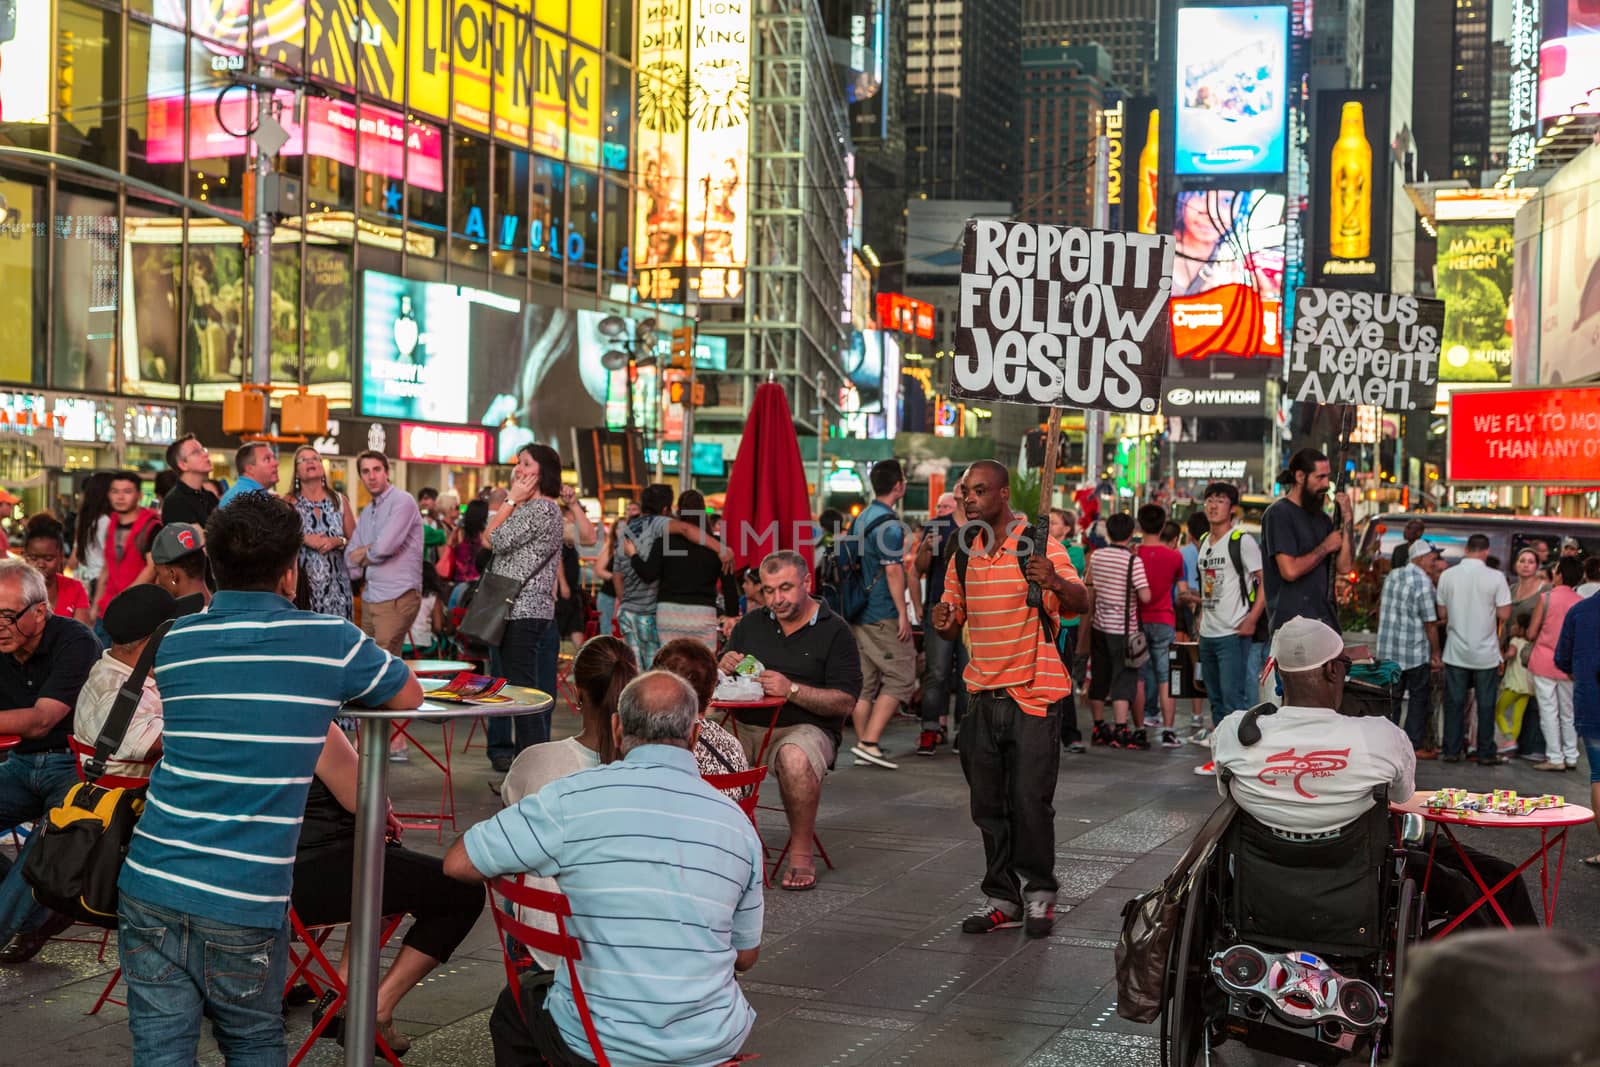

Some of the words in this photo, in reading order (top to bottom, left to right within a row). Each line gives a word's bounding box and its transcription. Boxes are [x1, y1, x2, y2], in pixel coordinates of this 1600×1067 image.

[699, 0, 741, 19] LION
[696, 24, 745, 49] KING
[423, 0, 505, 77] LION
[513, 4, 589, 111] KING
[1103, 99, 1123, 204] NOVOTEL
[975, 219, 1176, 290] RePenT!
[1449, 239, 1495, 255] MAKE
[1499, 238, 1513, 253] IT
[1449, 254, 1498, 270] REIGN
[960, 272, 1172, 342] FOLLOW
[1299, 287, 1419, 326] JeSUS
[953, 327, 1156, 412] JeSUS.
[1291, 342, 1309, 371] I
[1194, 389, 1261, 404] HYUNDAI
[1473, 413, 1502, 433] WE
[1505, 412, 1536, 433] FLY
[1538, 411, 1566, 432] TO
[1570, 410, 1600, 431] MO
[1485, 439, 1537, 459] THAN
[1541, 437, 1580, 458] ANY
[1583, 437, 1600, 457] O
